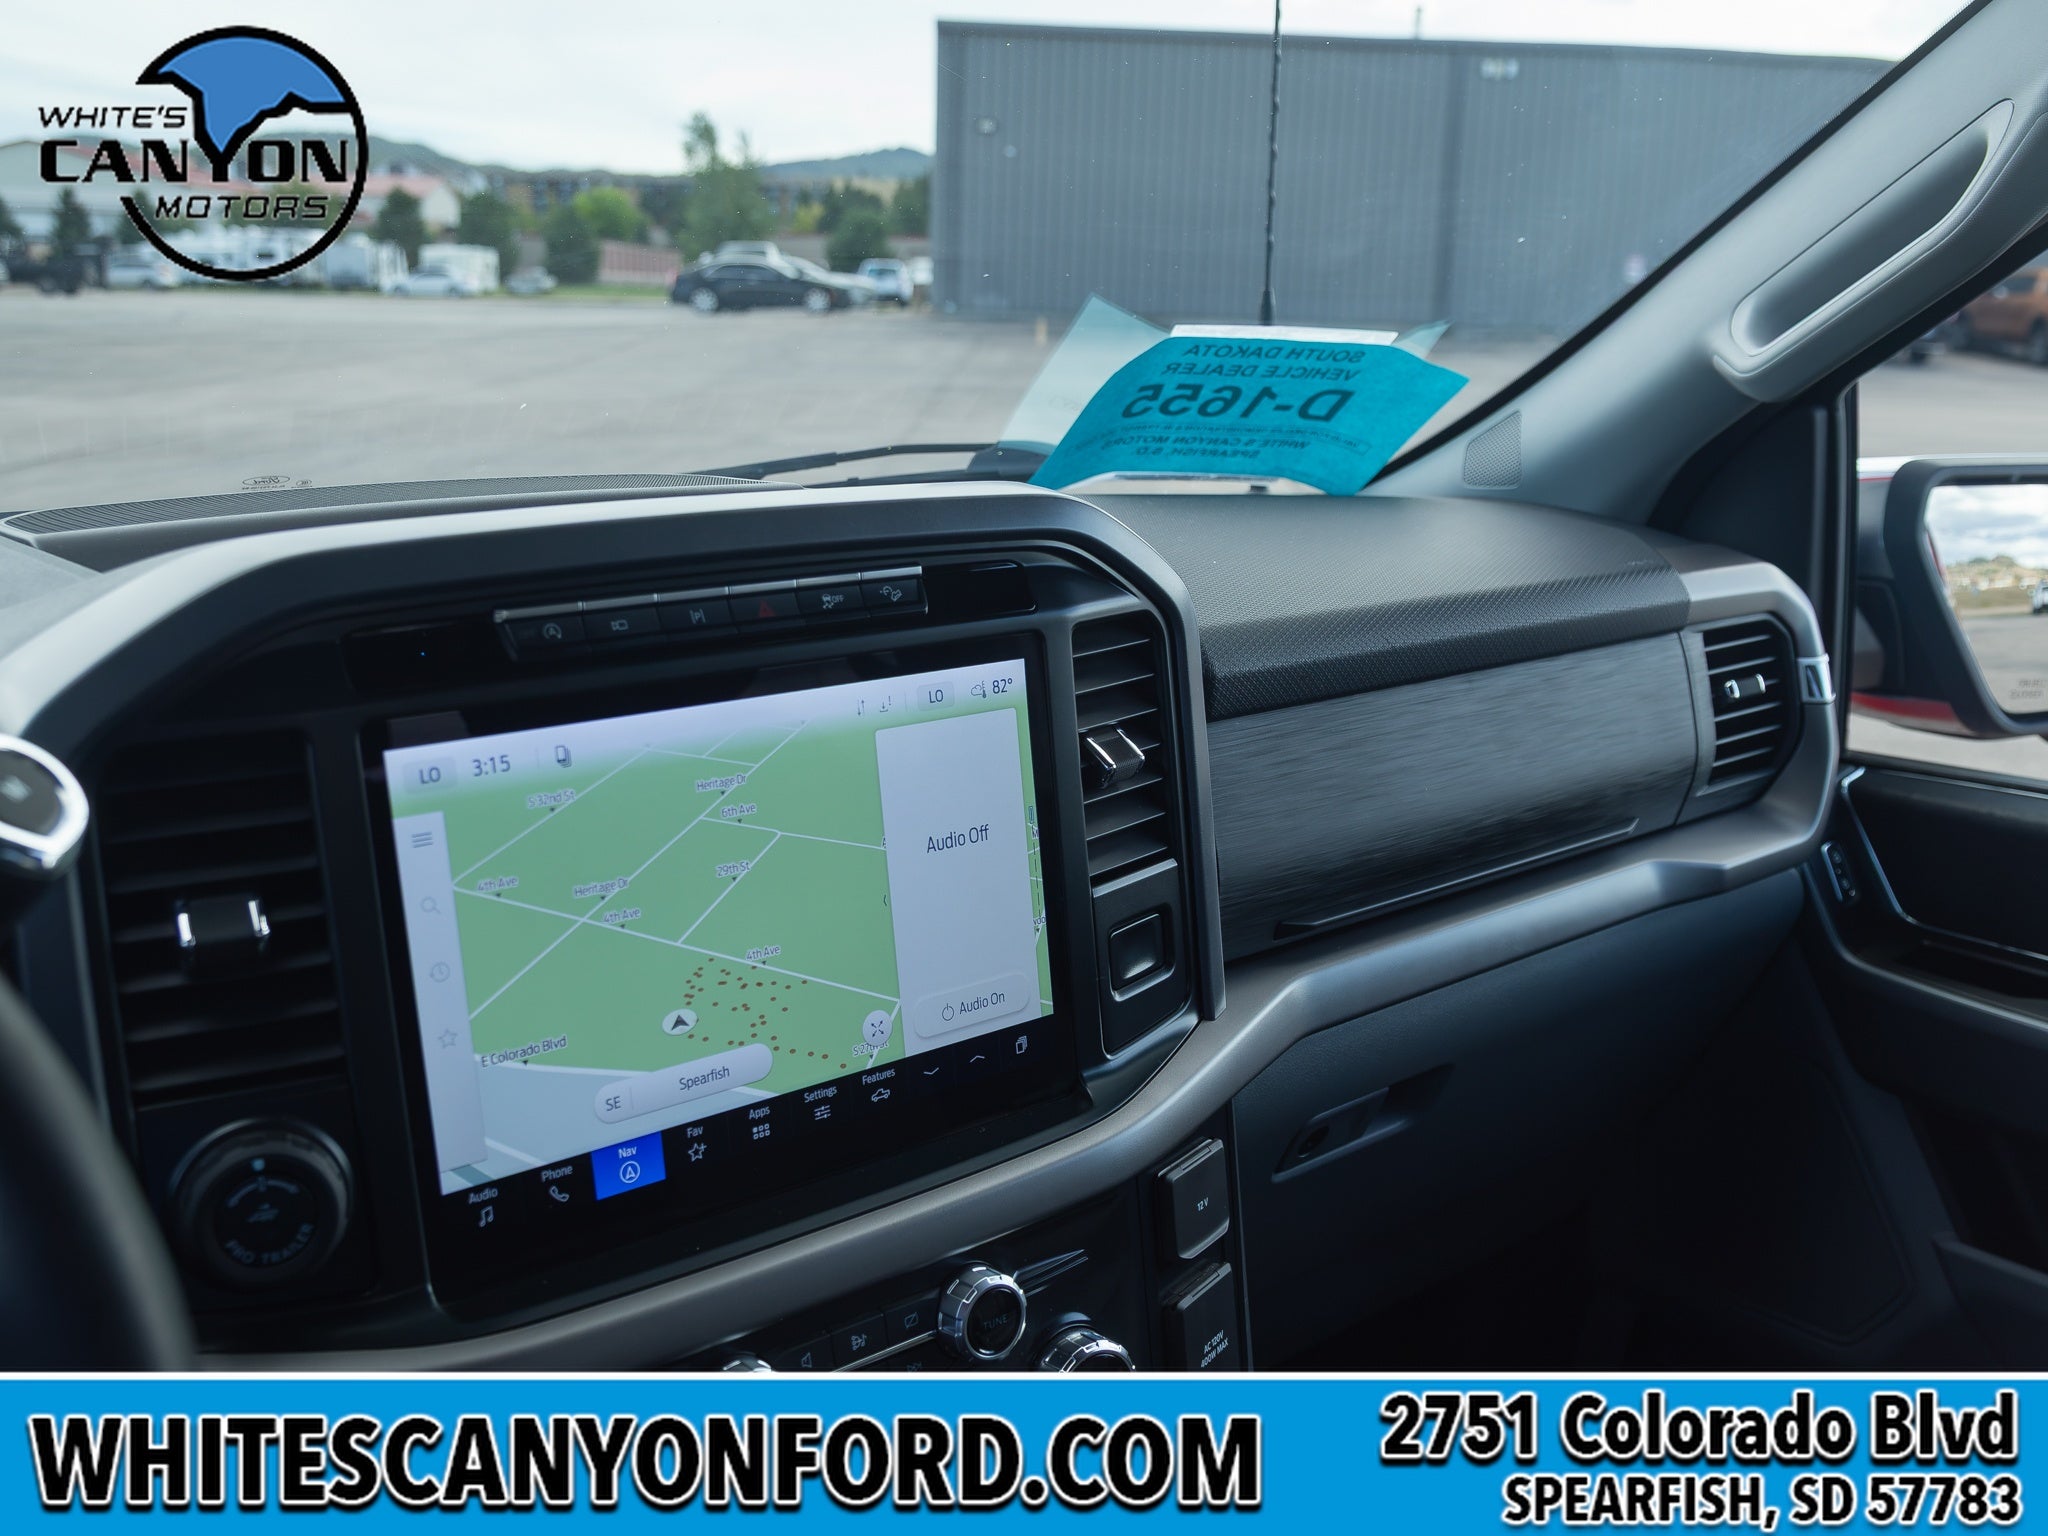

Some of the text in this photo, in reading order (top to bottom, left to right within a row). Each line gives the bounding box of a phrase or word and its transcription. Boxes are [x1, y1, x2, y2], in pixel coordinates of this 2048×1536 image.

[992, 677, 1013, 696] 82°
[928, 688, 944, 705] LO
[471, 753, 512, 778] 3:15
[418, 766, 442, 786] LO
[697, 773, 746, 791] Heritage Dr
[721, 804, 756, 818] 6th Ave
[926, 823, 990, 854] Audio Off
[717, 860, 750, 877] 29th St
[574, 881, 617, 897] Heritage
[603, 908, 641, 923] 4th Ave
[746, 946, 781, 961] 4th Ave
[959, 992, 1006, 1015] Audio On
[481, 1035, 567, 1068] E Colorado Blvd
[678, 1066, 730, 1092] Spearfish
[862, 1067, 896, 1086] Features
[803, 1084, 837, 1103] Settings
[605, 1095, 622, 1112] SE
[749, 1105, 770, 1121] Apps
[687, 1124, 704, 1139] Fav
[618, 1145, 637, 1159] Nav
[541, 1164, 573, 1183] Phone
[468, 1186, 499, 1205] Audio
[1203, 1341, 1212, 1354] AC
[1216, 1337, 1229, 1355] MAX
